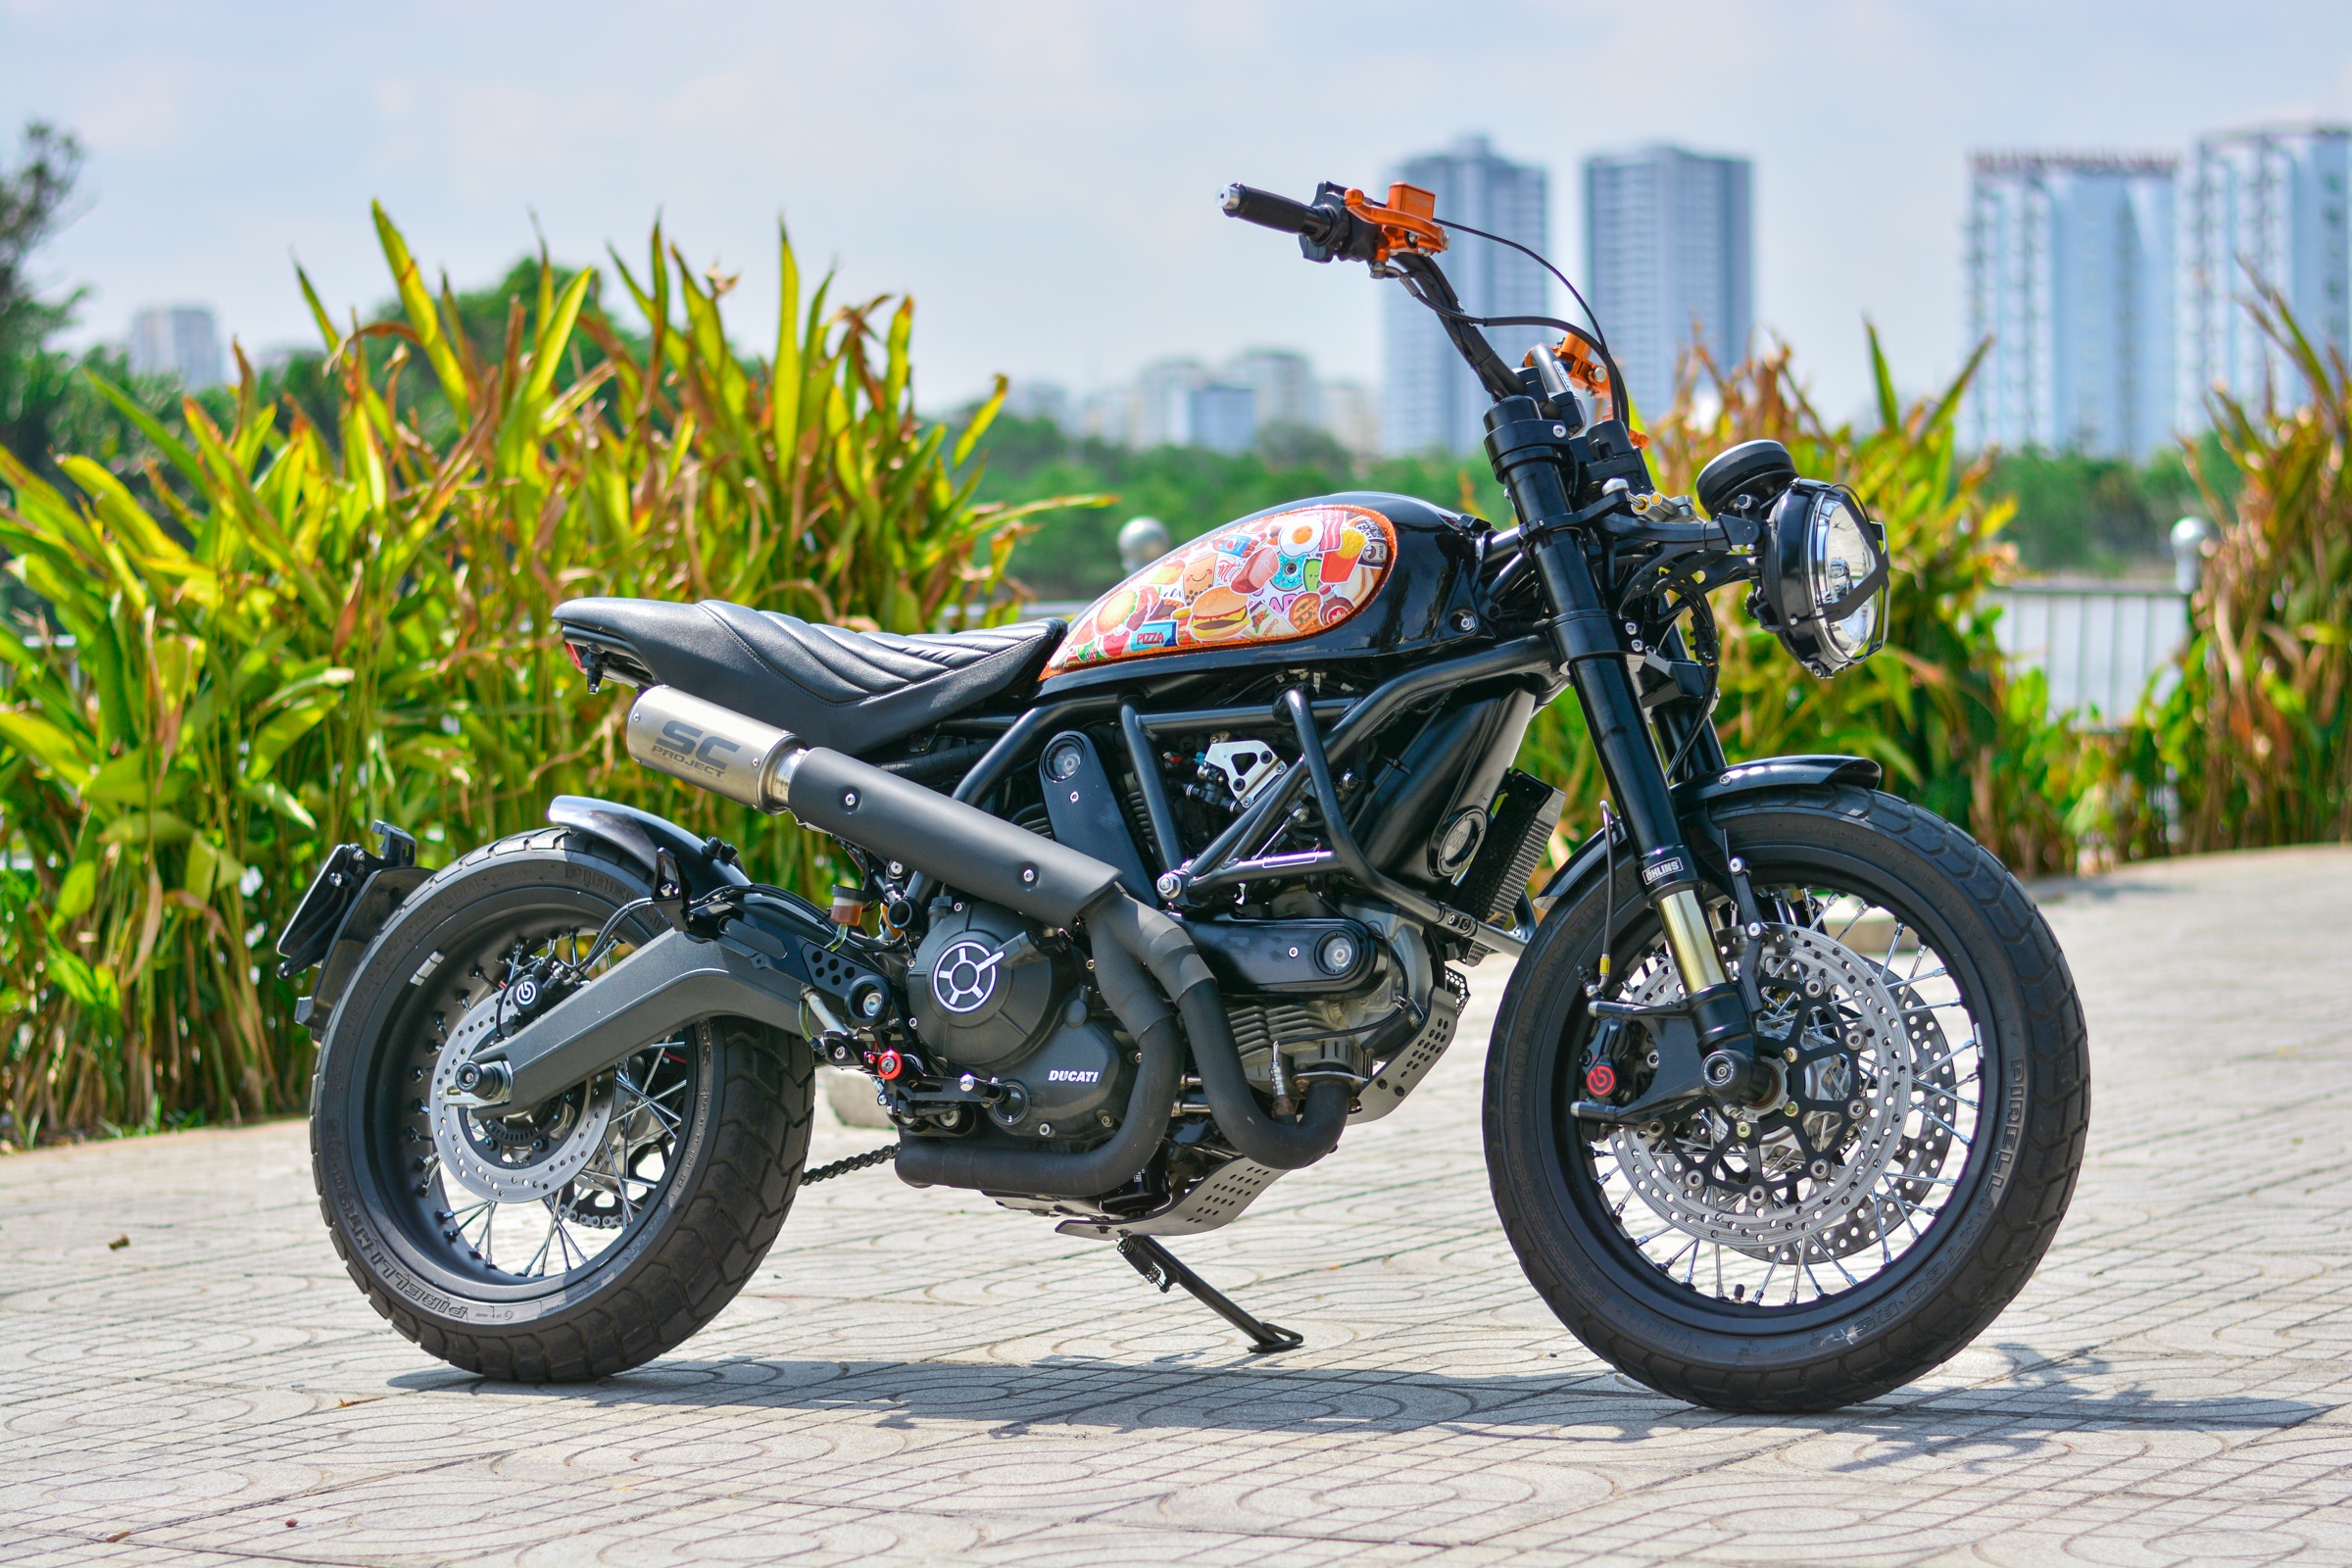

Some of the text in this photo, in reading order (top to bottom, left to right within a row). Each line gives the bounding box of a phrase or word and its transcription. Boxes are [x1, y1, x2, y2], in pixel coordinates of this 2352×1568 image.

[1136, 632, 1164, 645] PIZZA
[652, 745, 725, 778] PROJECT
[655, 720, 741, 771] SC
[1645, 860, 1680, 882] ÖHLINS
[1509, 968, 1556, 1114] PIRELLI
[1048, 1069, 1099, 1084] DUCATI
[331, 1170, 376, 1251] MT60
[1852, 1058, 2026, 1338] PIRELLI MT60 RS
[369, 1251, 468, 1319] PIRELLI
